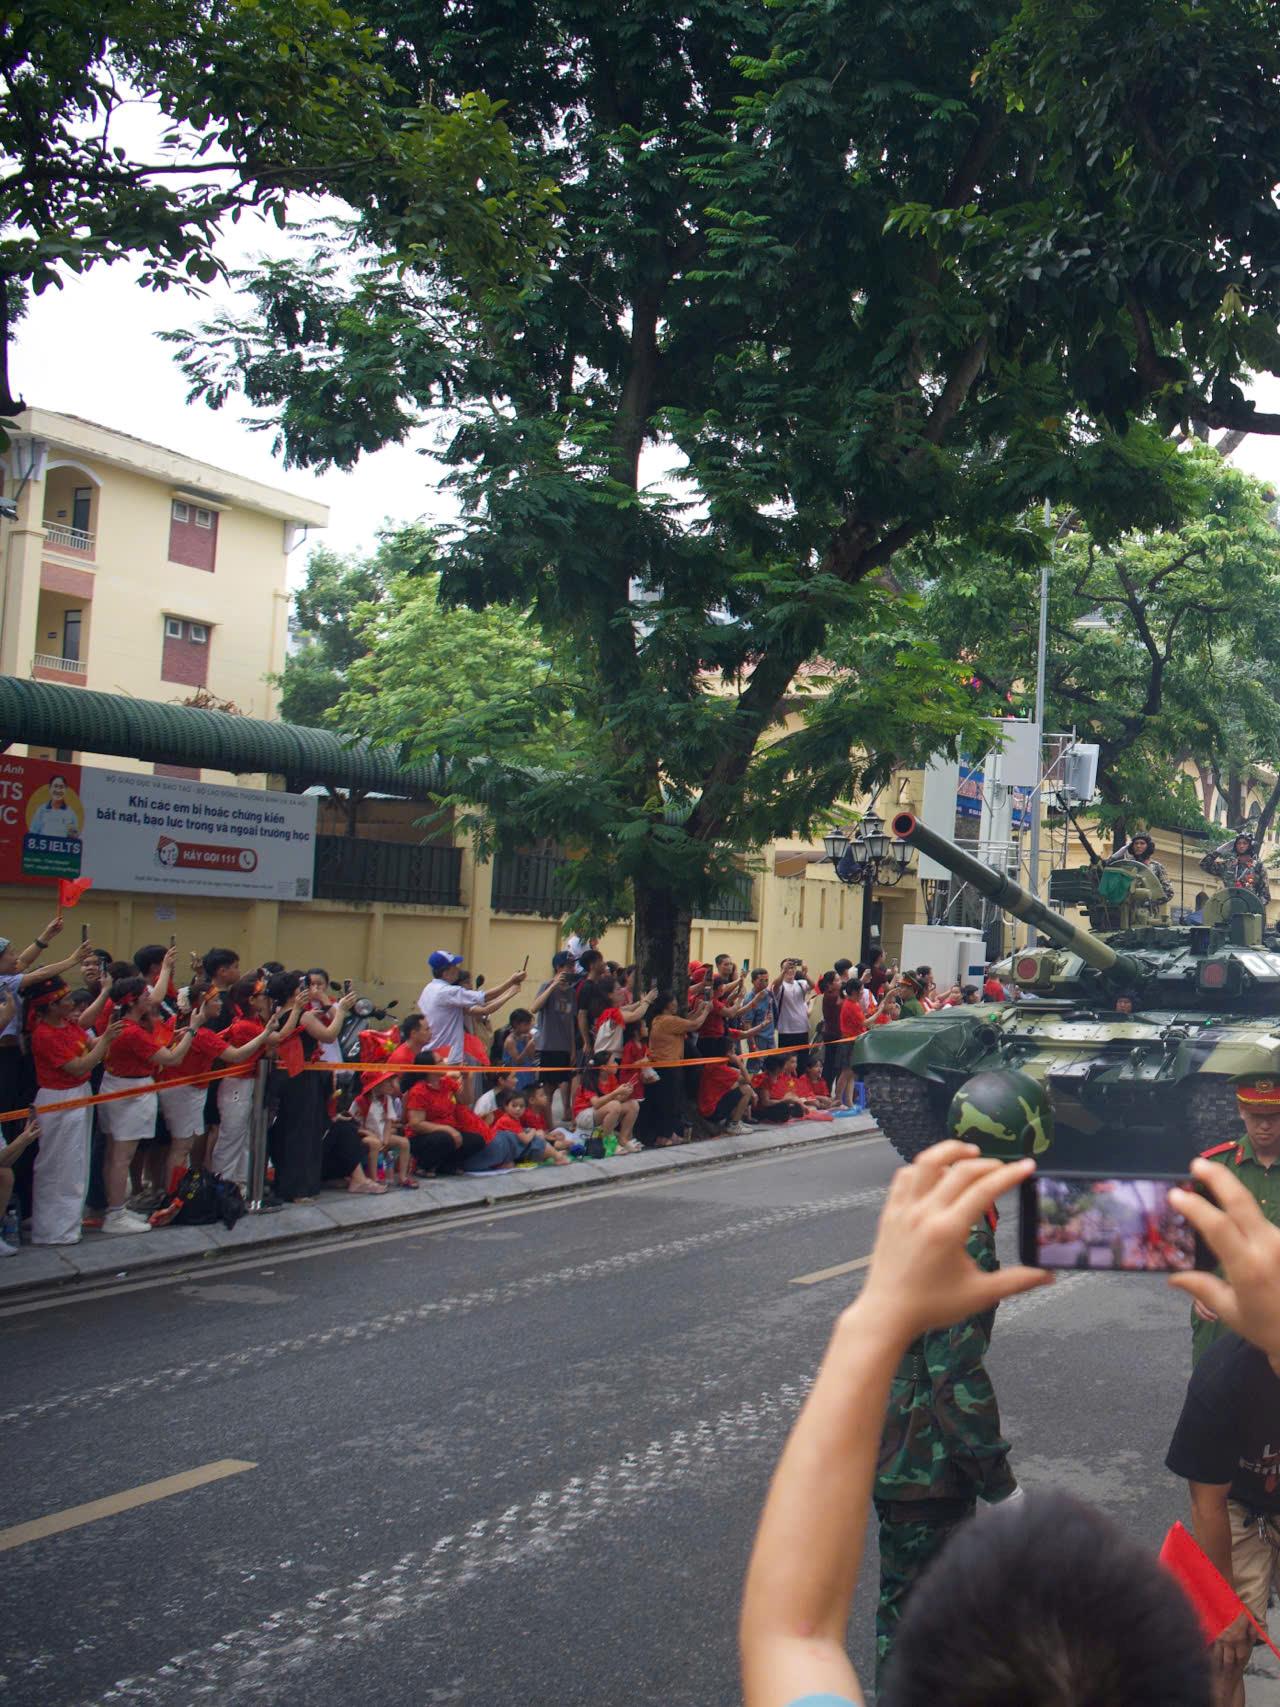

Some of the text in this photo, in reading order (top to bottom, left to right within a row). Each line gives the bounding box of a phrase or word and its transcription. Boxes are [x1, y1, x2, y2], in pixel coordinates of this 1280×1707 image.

[128, 795, 148, 809] Khi
[150, 799, 171, 811] các
[173, 803, 190, 814] em
[186, 818, 214, 834] trong
[293, 829, 310, 842] học
[27, 838, 81, 854] 8.5 IELTS
